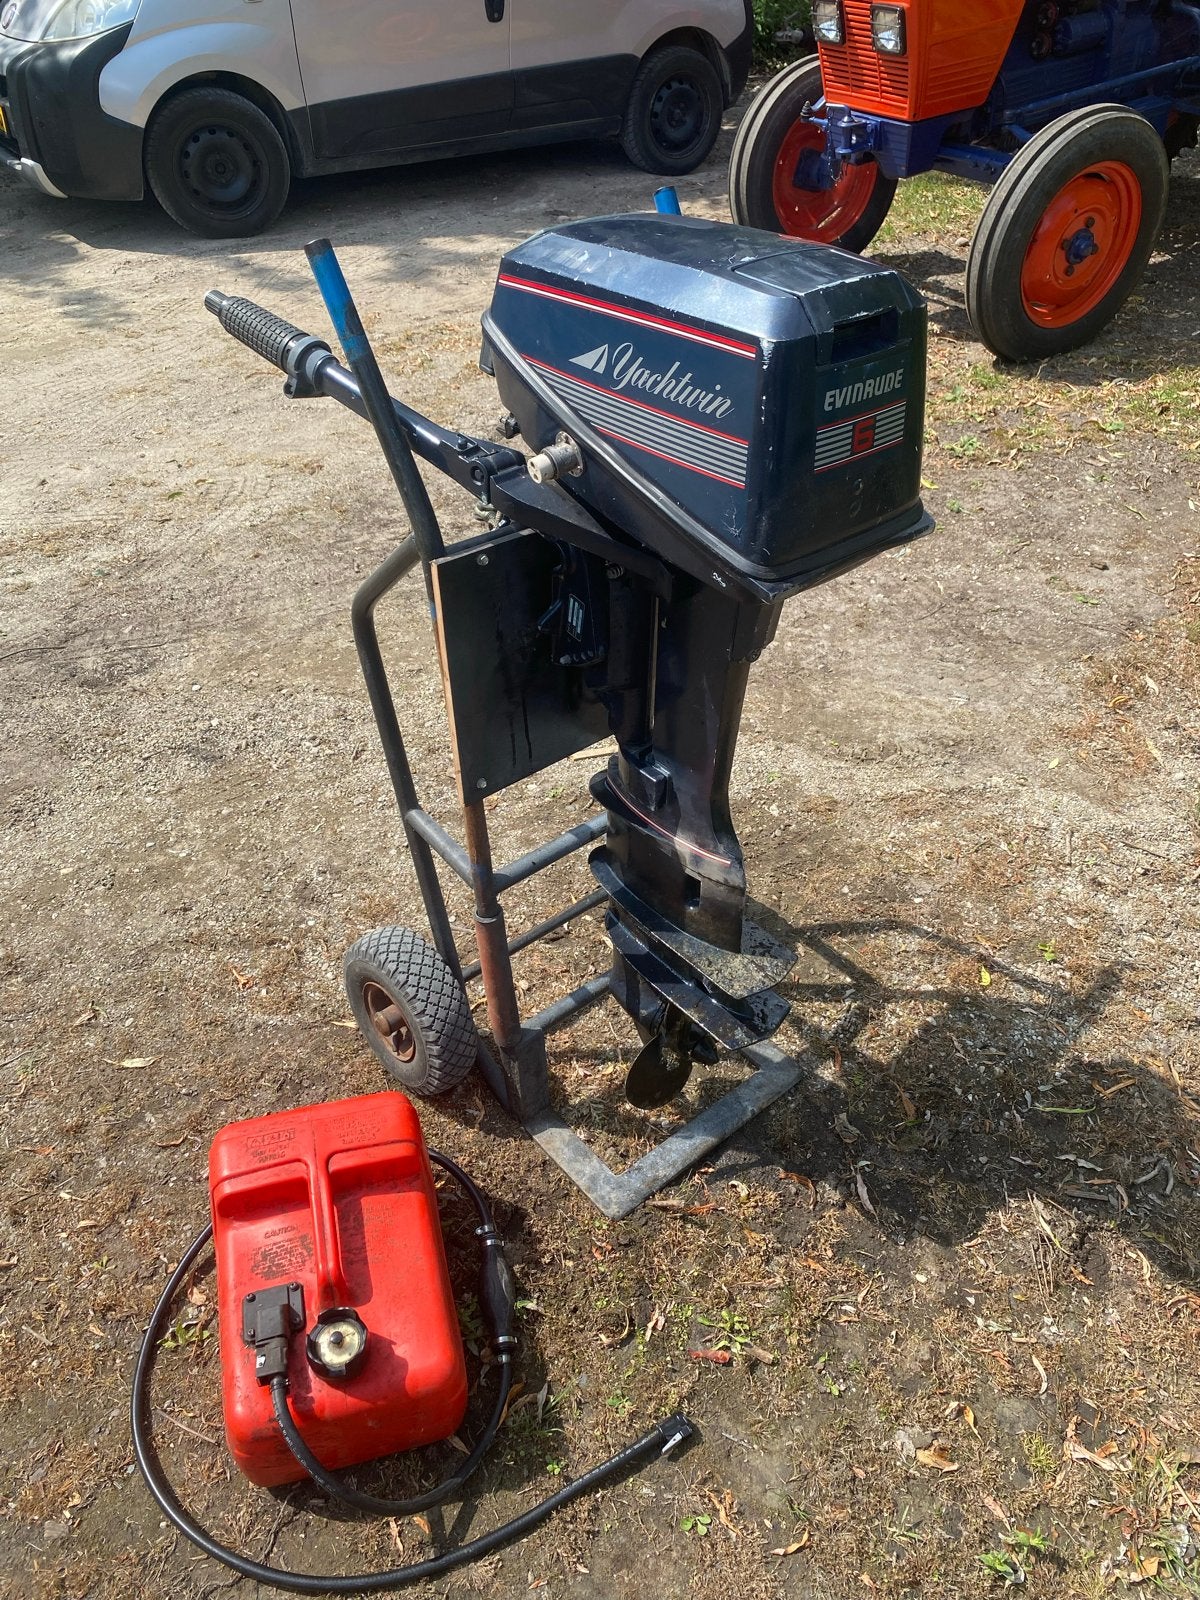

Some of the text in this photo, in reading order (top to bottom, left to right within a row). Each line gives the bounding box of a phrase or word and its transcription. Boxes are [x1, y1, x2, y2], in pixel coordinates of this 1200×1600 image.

[609, 342, 735, 419] Yachtwin
[823, 368, 905, 412] EVINRUDE
[852, 416, 876, 453] 6
